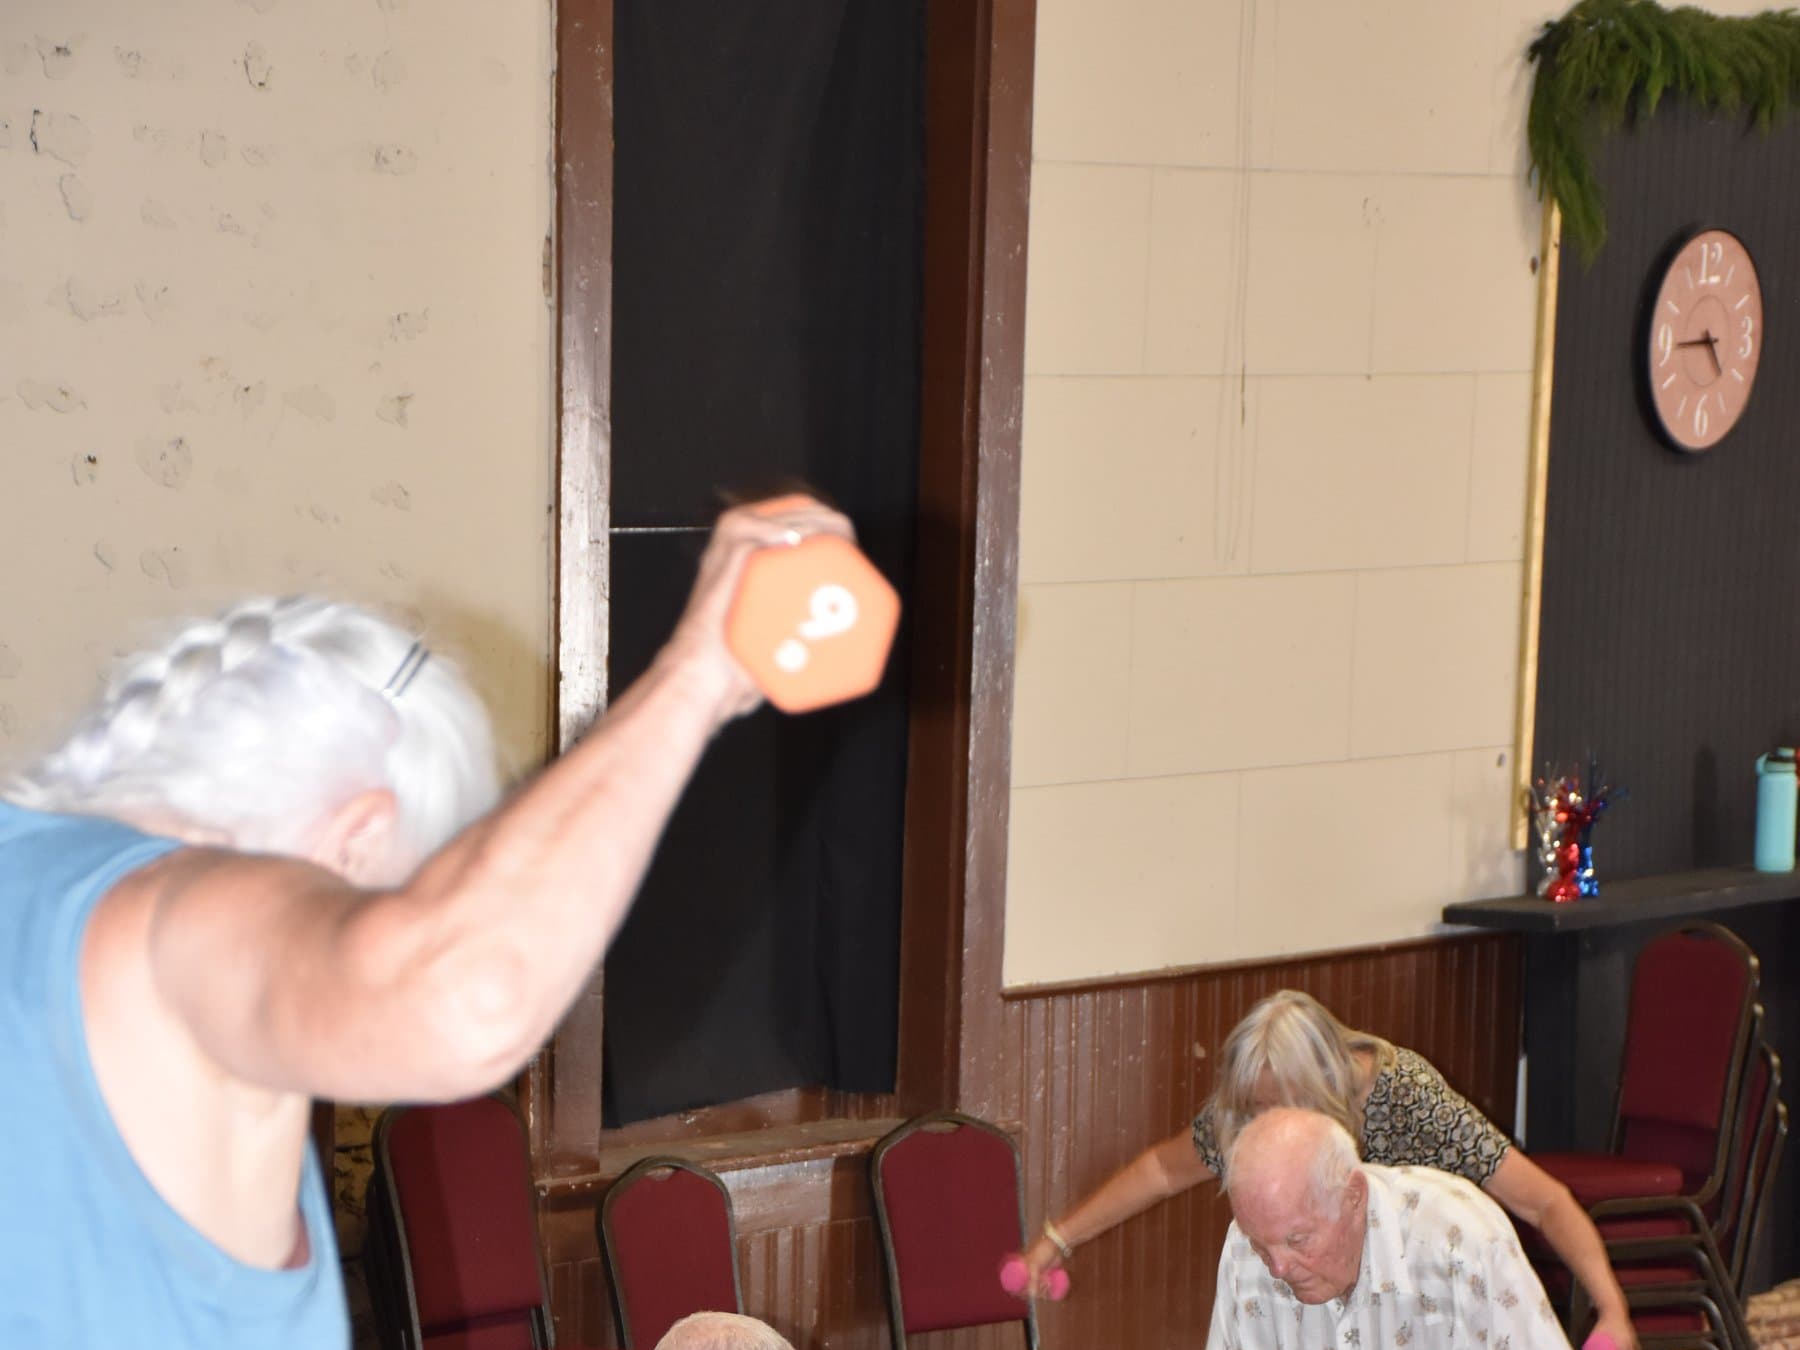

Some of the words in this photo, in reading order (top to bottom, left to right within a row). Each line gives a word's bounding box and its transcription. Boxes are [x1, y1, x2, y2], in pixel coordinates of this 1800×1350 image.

[1699, 242, 1723, 285] 12
[1658, 323, 1673, 367] 9
[1739, 316, 1753, 358] 3
[1693, 394, 1709, 437] 6
